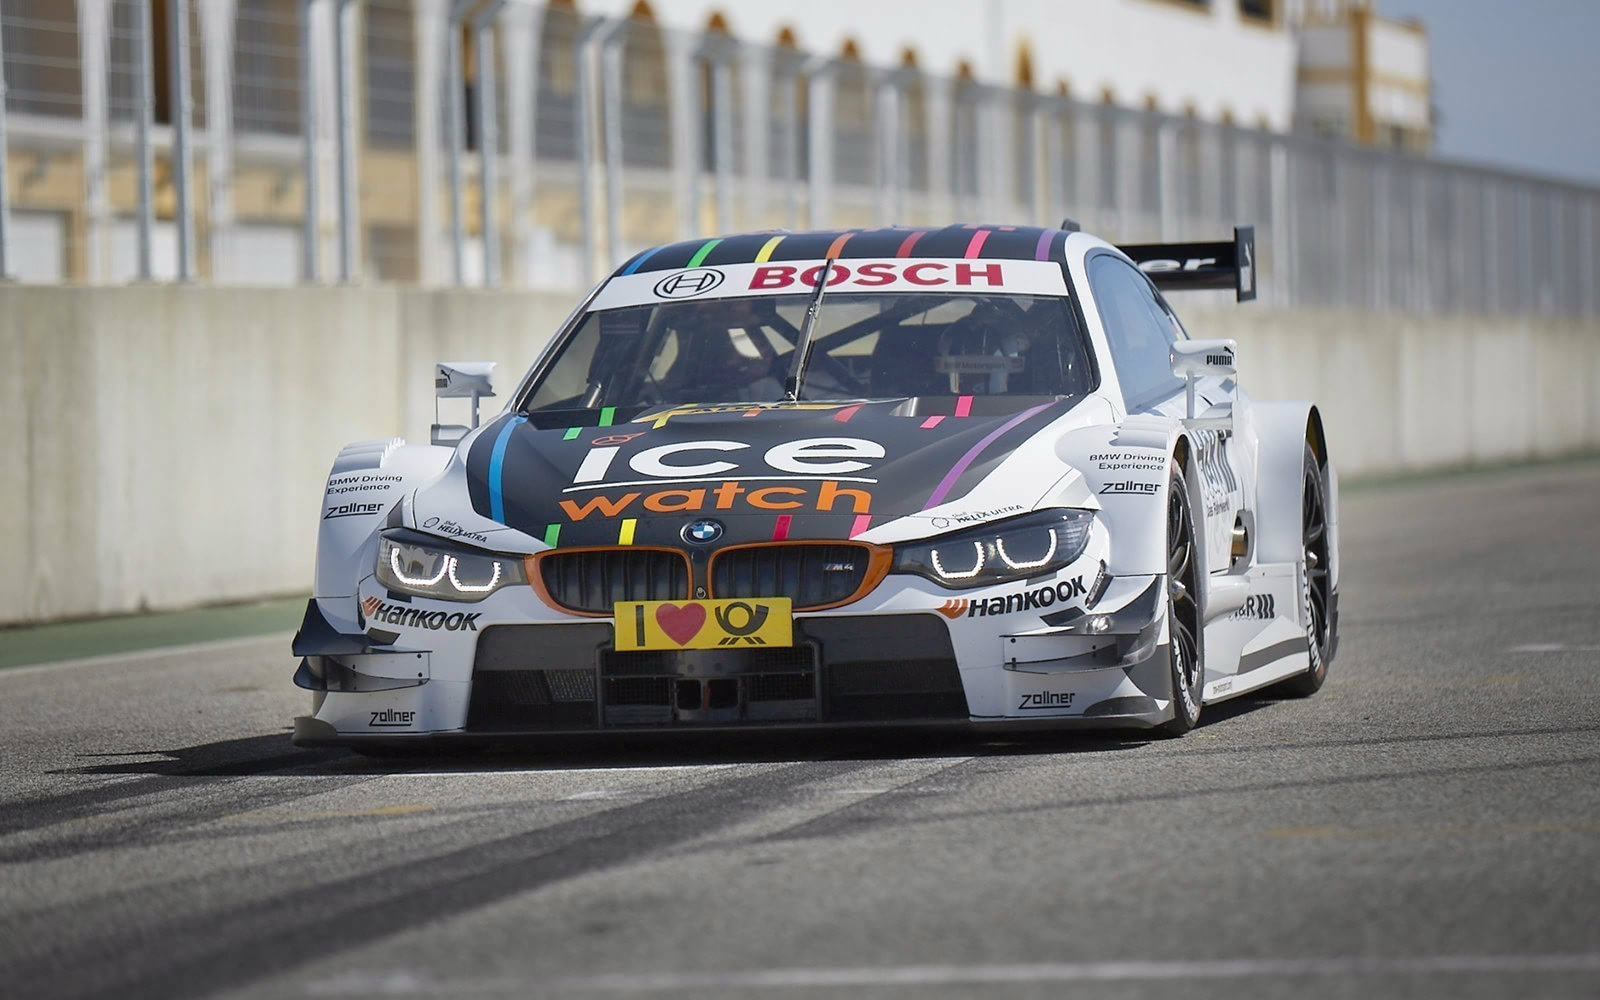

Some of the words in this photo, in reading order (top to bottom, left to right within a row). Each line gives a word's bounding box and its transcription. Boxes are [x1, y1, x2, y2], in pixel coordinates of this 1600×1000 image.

[748, 263, 1004, 290] BOSCH
[1206, 355, 1232, 366] PUMA
[572, 437, 886, 484] ice
[1089, 453, 1121, 461] BMW
[1124, 453, 1165, 463] Driving
[1098, 463, 1164, 471] Experience
[329, 476, 360, 486] BMW
[327, 484, 391, 495] Experience
[559, 481, 873, 522] watch
[636, 605, 645, 647] I
